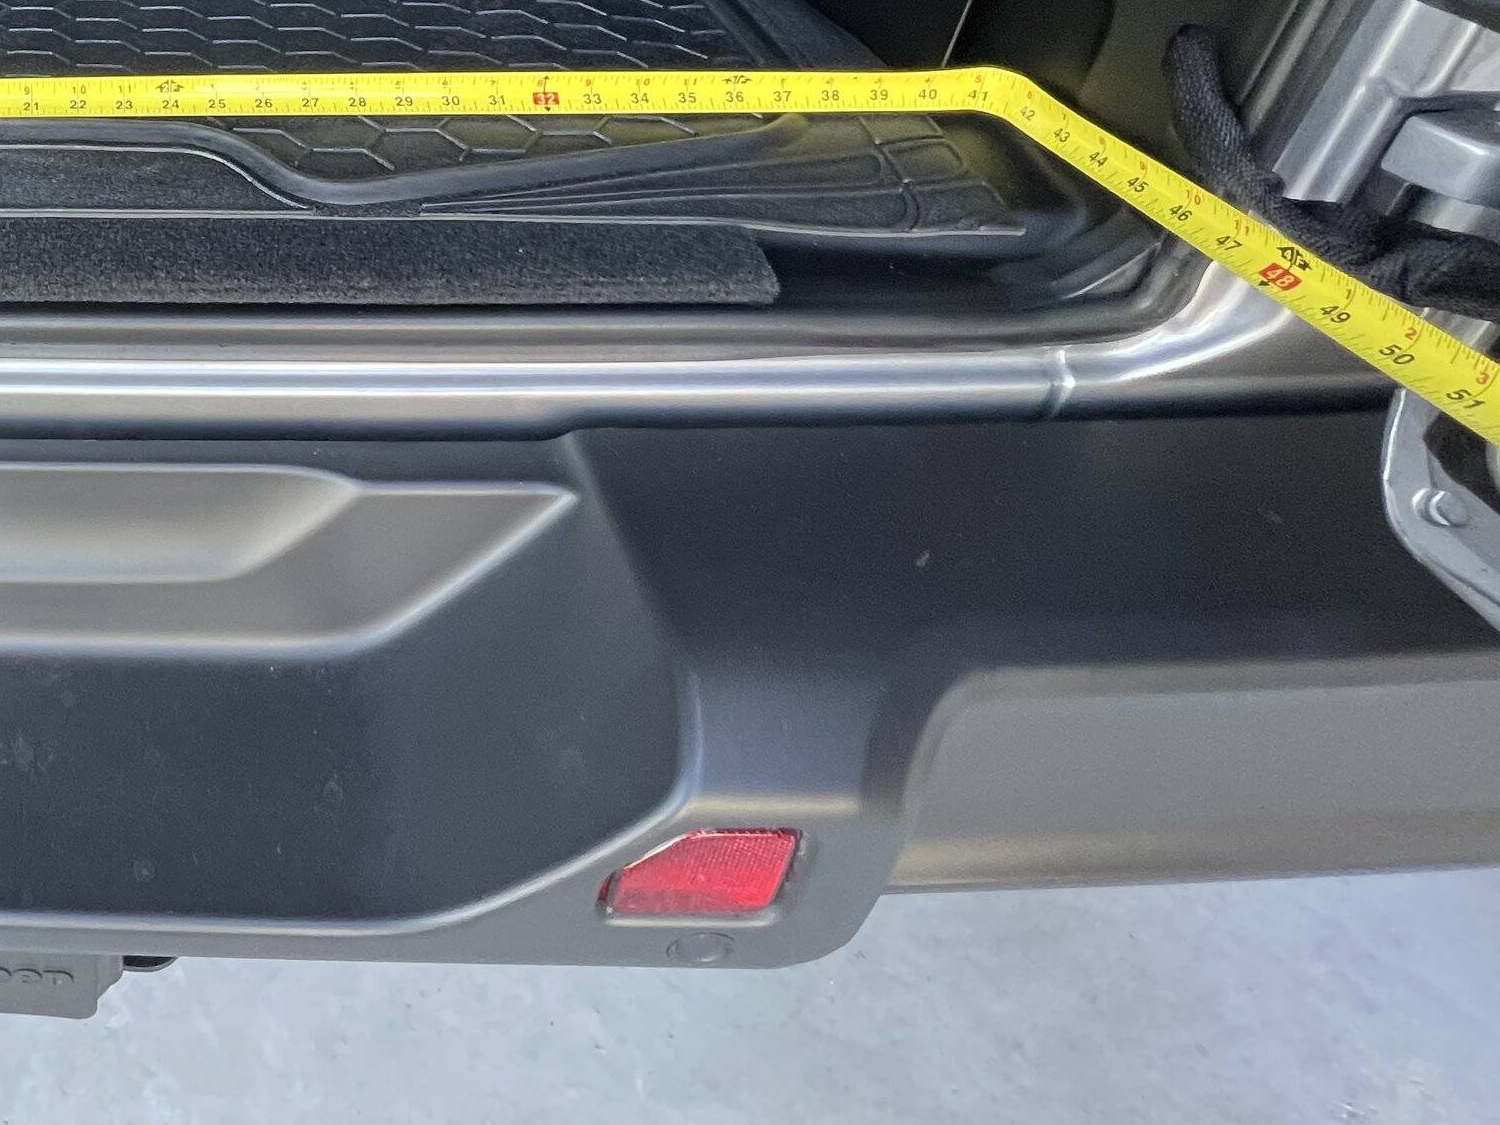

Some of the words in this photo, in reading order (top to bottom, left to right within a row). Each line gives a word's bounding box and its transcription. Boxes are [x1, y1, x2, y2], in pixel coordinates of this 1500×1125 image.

[23, 86, 30, 95] 9
[72, 85, 87, 95] 10
[118, 84, 132, 94] 11
[1404, 327, 1417, 341] 2
[1475, 373, 1490, 385] 3
[23, 102, 39, 111] 21
[69, 100, 87, 109] 22
[115, 100, 133, 110] 23
[162, 99, 179, 109] 24
[208, 98, 226, 109] 25
[255, 98, 273, 108] 26
[301, 98, 319, 108] 27
[348, 97, 366, 107] 28
[395, 96, 413, 107] 29
[442, 95, 460, 106] 30
[488, 95, 506, 106] 31
[536, 93, 556, 104] 32
[583, 93, 601, 104] 33
[630, 93, 649, 104] 34
[678, 92, 697, 104] 35
[725, 91, 744, 103] 36
[773, 90, 792, 102] 37
[821, 90, 840, 101] 38
[870, 89, 888, 101] 39
[918, 89, 937, 100] 40
[968, 90, 988, 102] 41
[1020, 106, 1036, 121] 42
[1053, 128, 1070, 143] 43
[1089, 152, 1108, 167] 44
[1127, 177, 1149, 193] 45
[1169, 205, 1193, 222] 46
[1216, 235, 1243, 251] 47
[1266, 268, 1295, 287] 48
[1319, 305, 1351, 324] 49
[1379, 344, 1415, 365] 50
[1446, 388, 1485, 409] 51
